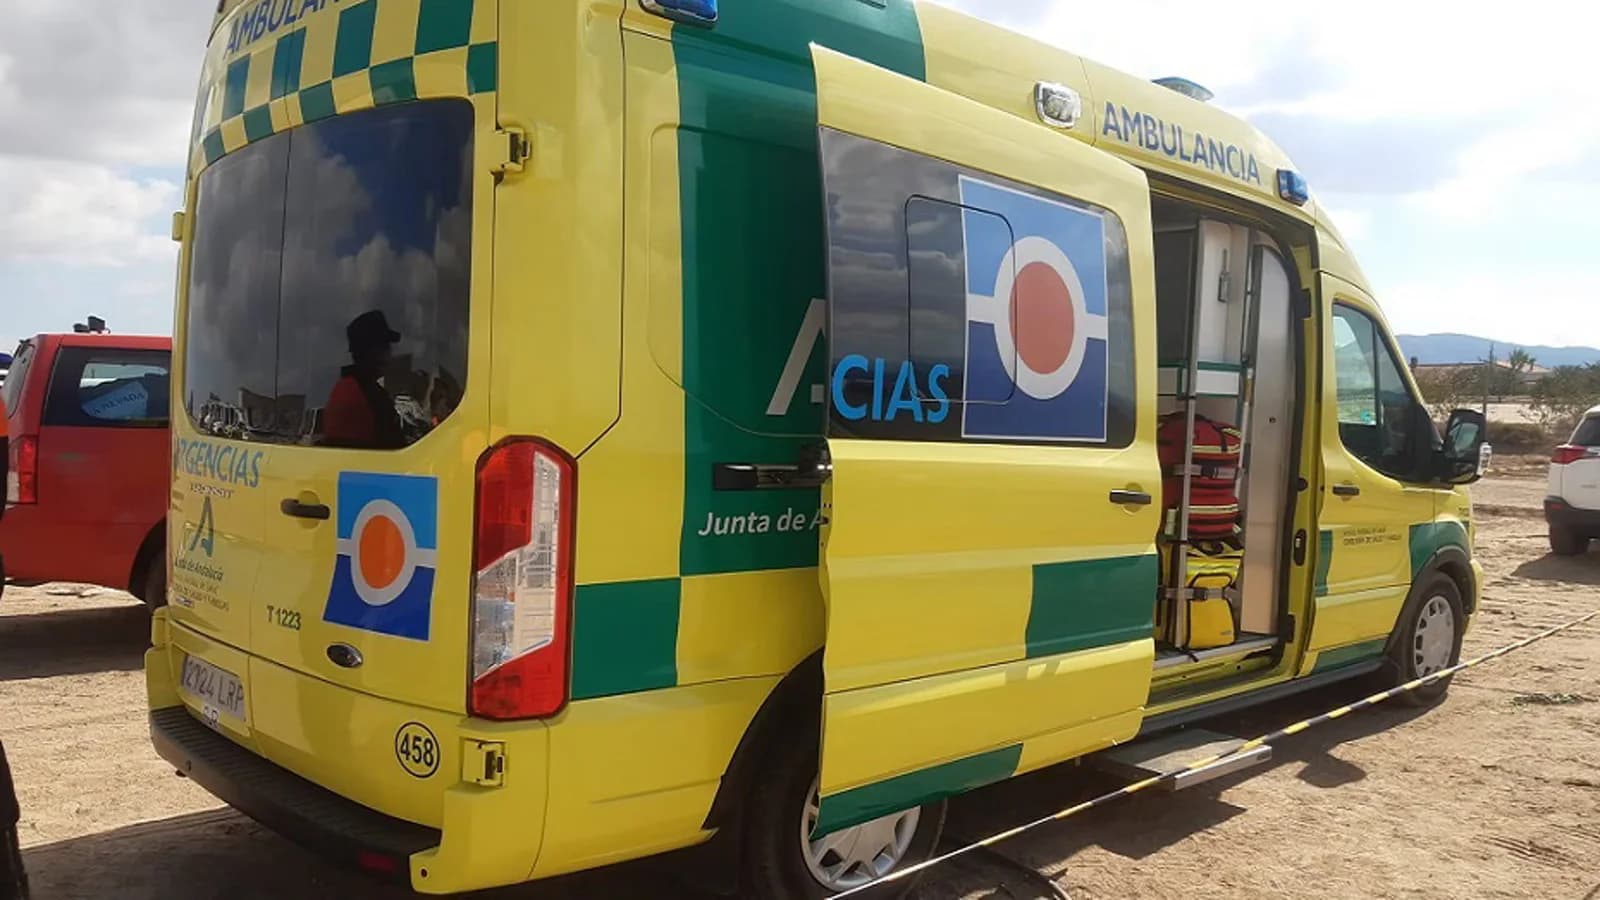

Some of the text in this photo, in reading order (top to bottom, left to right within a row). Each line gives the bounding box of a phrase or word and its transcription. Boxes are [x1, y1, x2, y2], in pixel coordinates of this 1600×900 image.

[223, 0, 339, 59] AMBULA
[1103, 101, 1261, 185] AMBULANCIA
[832, 354, 949, 423] CIAS
[697, 511, 770, 536] Junta
[777, 507, 807, 532] de
[266, 604, 302, 631] T 1223
[400, 732, 434, 767] 458
